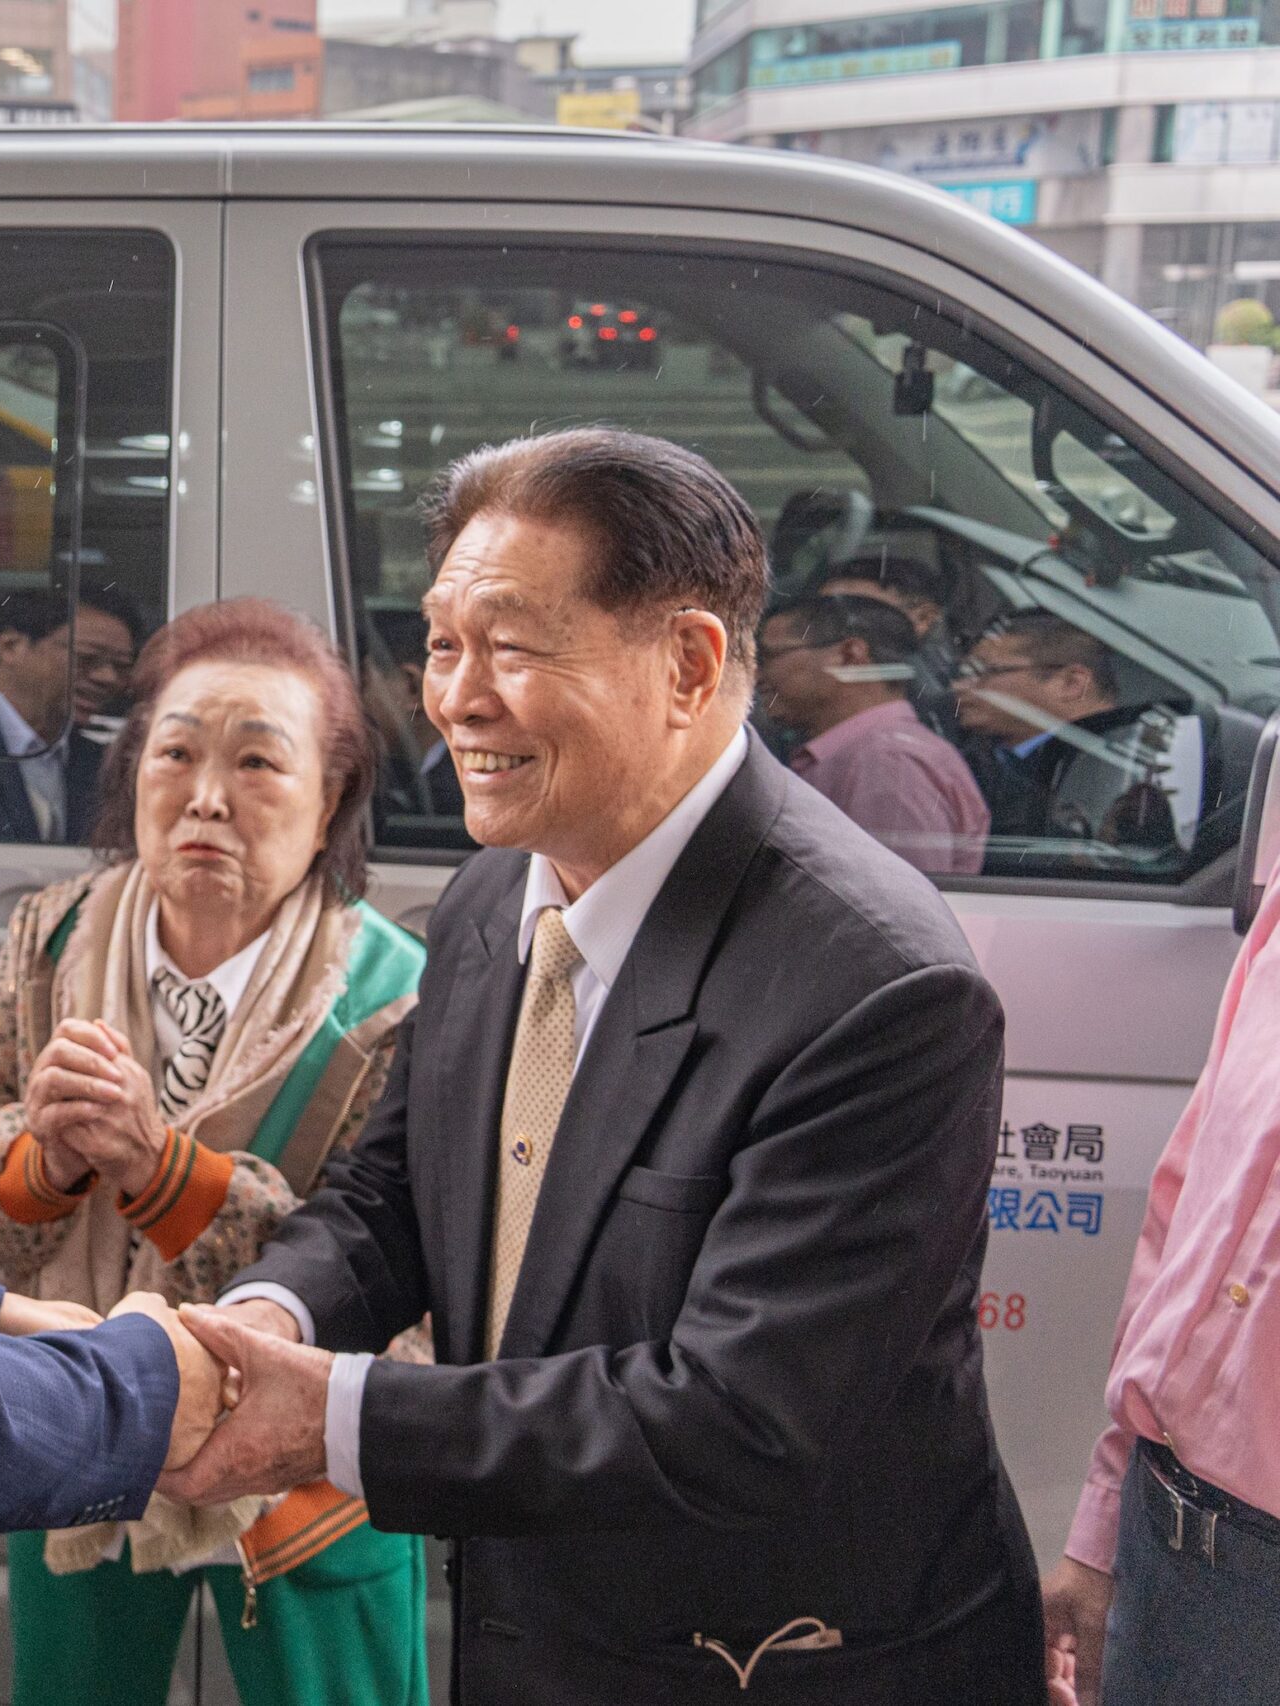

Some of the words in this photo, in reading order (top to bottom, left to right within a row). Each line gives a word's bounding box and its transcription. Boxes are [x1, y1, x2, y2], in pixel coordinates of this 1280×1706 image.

[1030, 1164, 1104, 1183] Taoyuan
[988, 1187, 1105, 1237] 限公司
[978, 1292, 1026, 1331] 68
